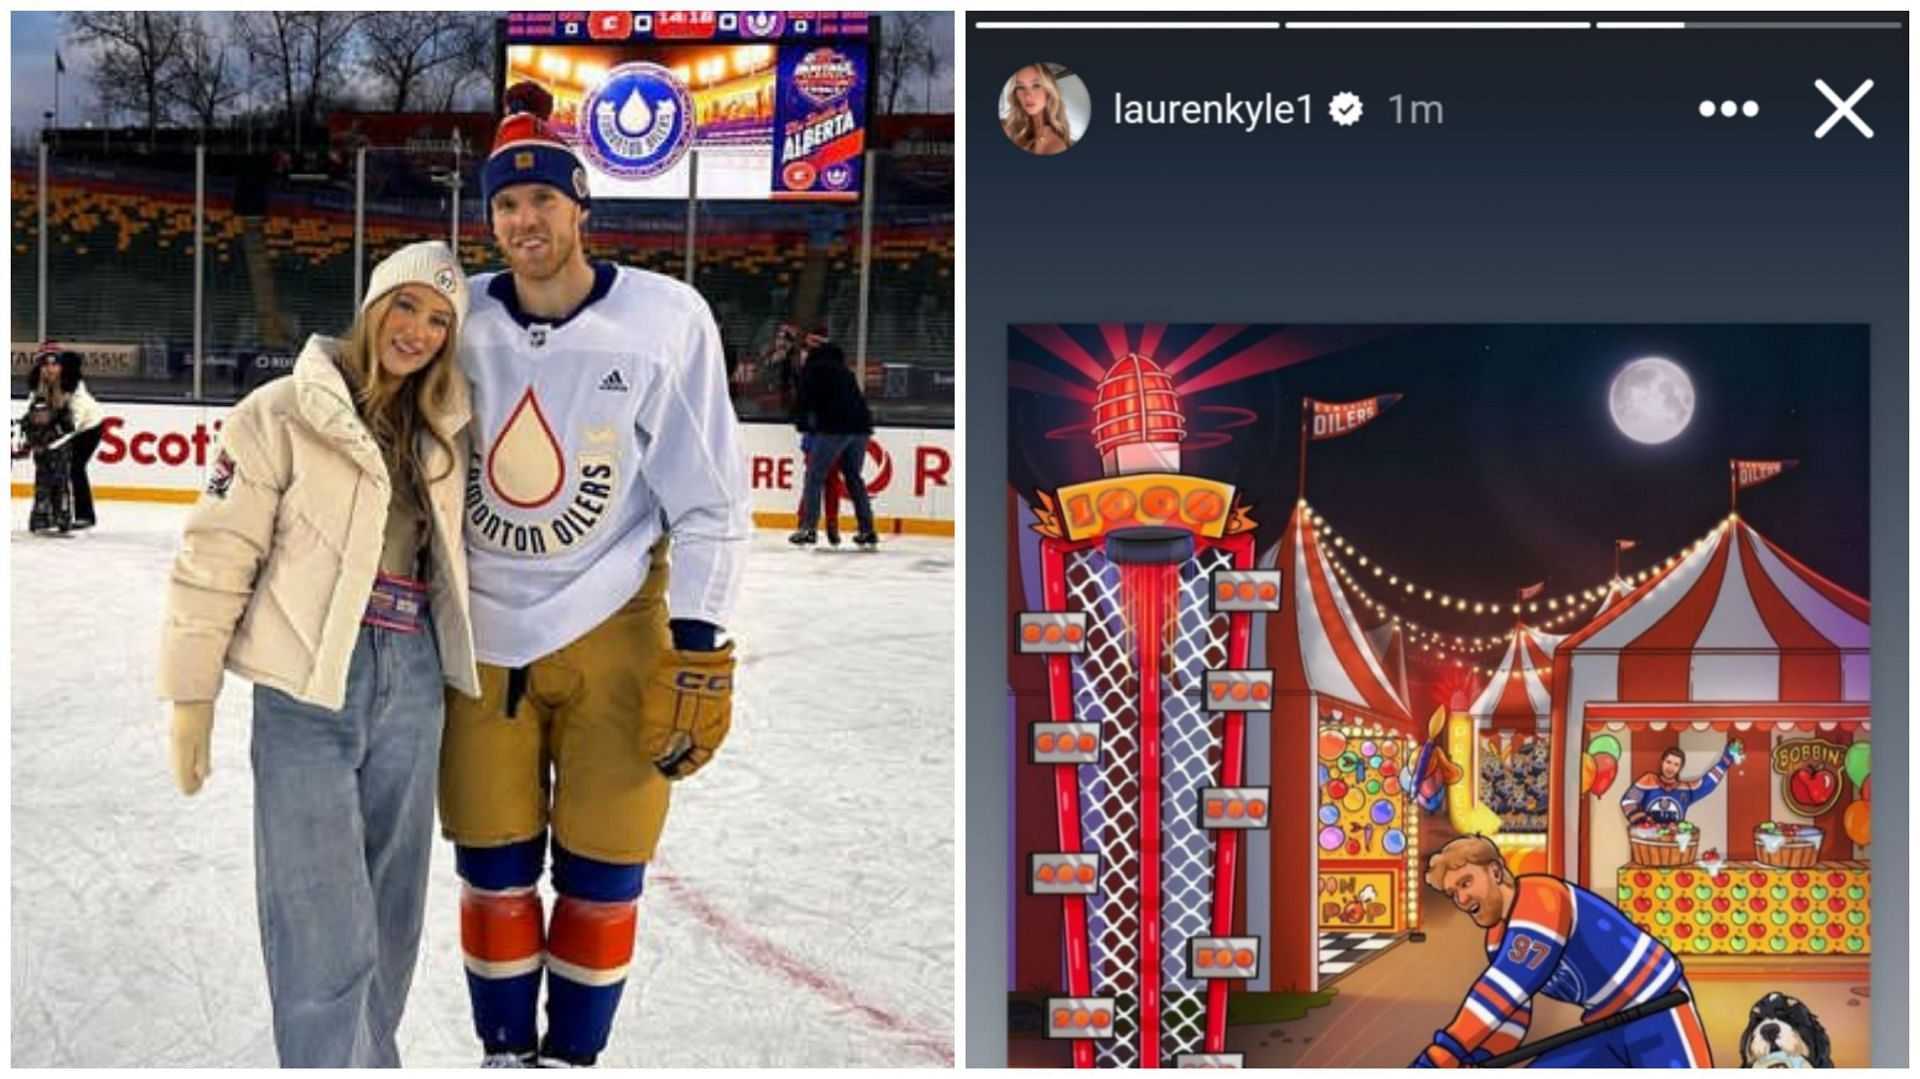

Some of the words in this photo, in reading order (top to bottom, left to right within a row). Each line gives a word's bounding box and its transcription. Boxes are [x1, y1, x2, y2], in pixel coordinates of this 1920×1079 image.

[783, 109, 854, 162] ALBERTA
[1313, 406, 1375, 436] OILERS
[914, 445, 952, 497] R
[552, 464, 611, 545] OILERS
[1067, 486, 1226, 528] 1000
[1507, 933, 1552, 971] 97
